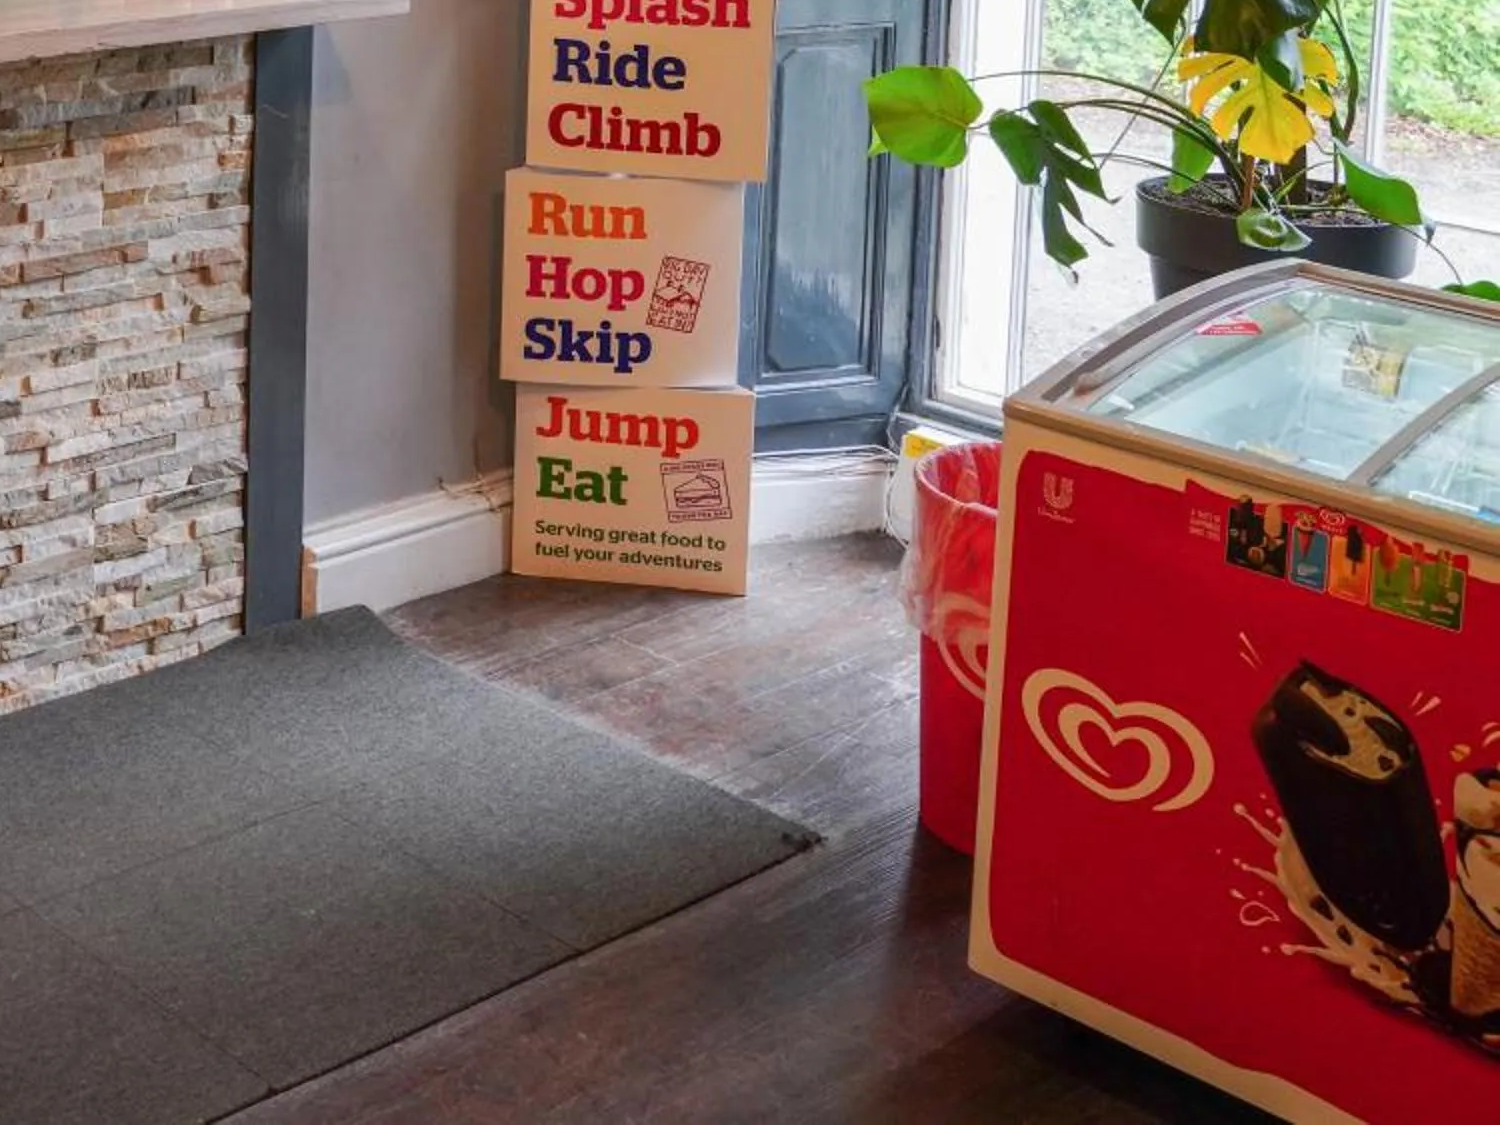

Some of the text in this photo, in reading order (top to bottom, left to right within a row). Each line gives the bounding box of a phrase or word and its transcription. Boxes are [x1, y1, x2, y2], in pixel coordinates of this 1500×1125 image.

[552, 38, 686, 91] Ride
[548, 103, 721, 158] Climb
[528, 192, 647, 240] Run
[525, 255, 644, 312] Hop
[523, 318, 652, 374] Skip
[535, 396, 699, 459] Jump
[535, 456, 628, 506] Eat
[535, 520, 726, 551] Serving great food to
[535, 541, 723, 573] fuel your adventures
